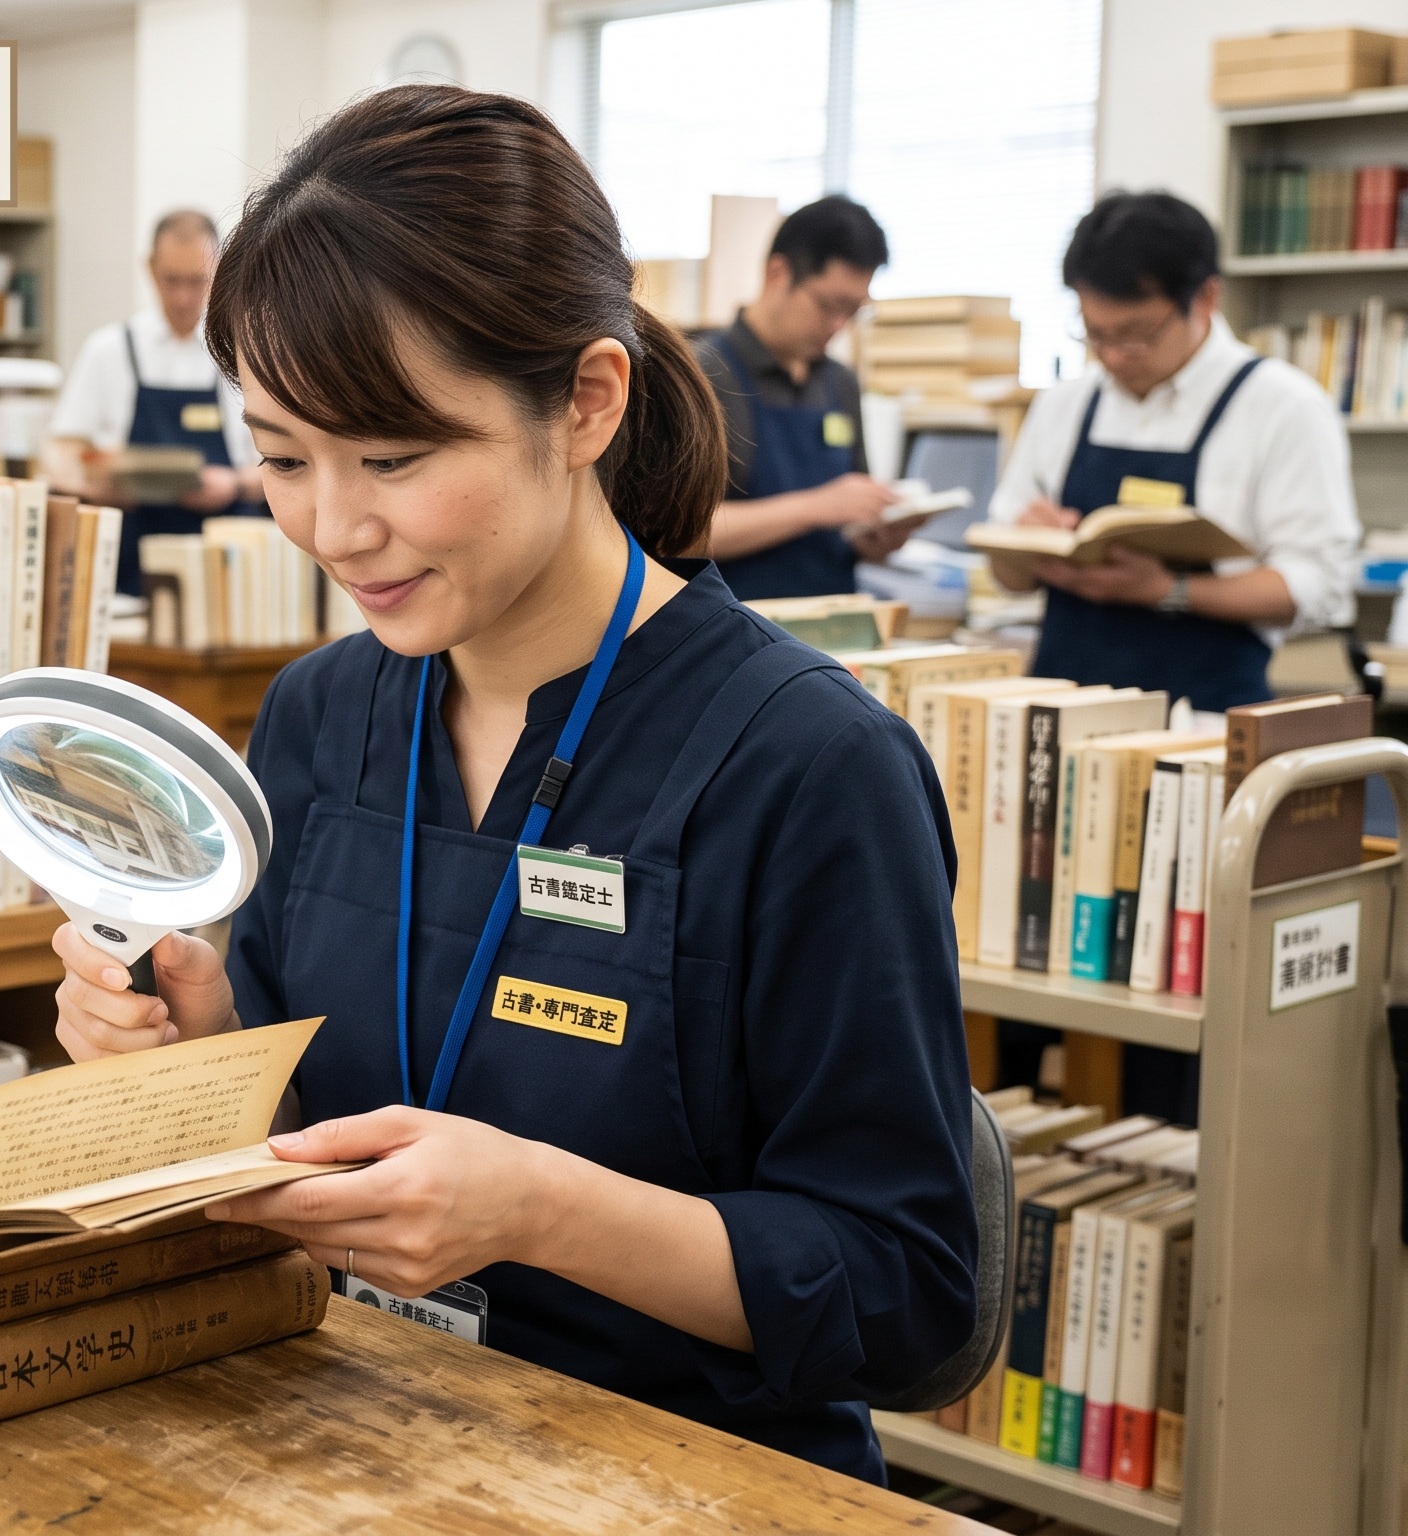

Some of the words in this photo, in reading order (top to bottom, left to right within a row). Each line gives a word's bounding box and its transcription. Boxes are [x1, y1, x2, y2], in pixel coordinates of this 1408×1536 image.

[528, 875, 614, 907] 古書鑑定士
[501, 989, 619, 1034] 古書・専門査定
[388, 1297, 455, 1334] 古書鑑定士
